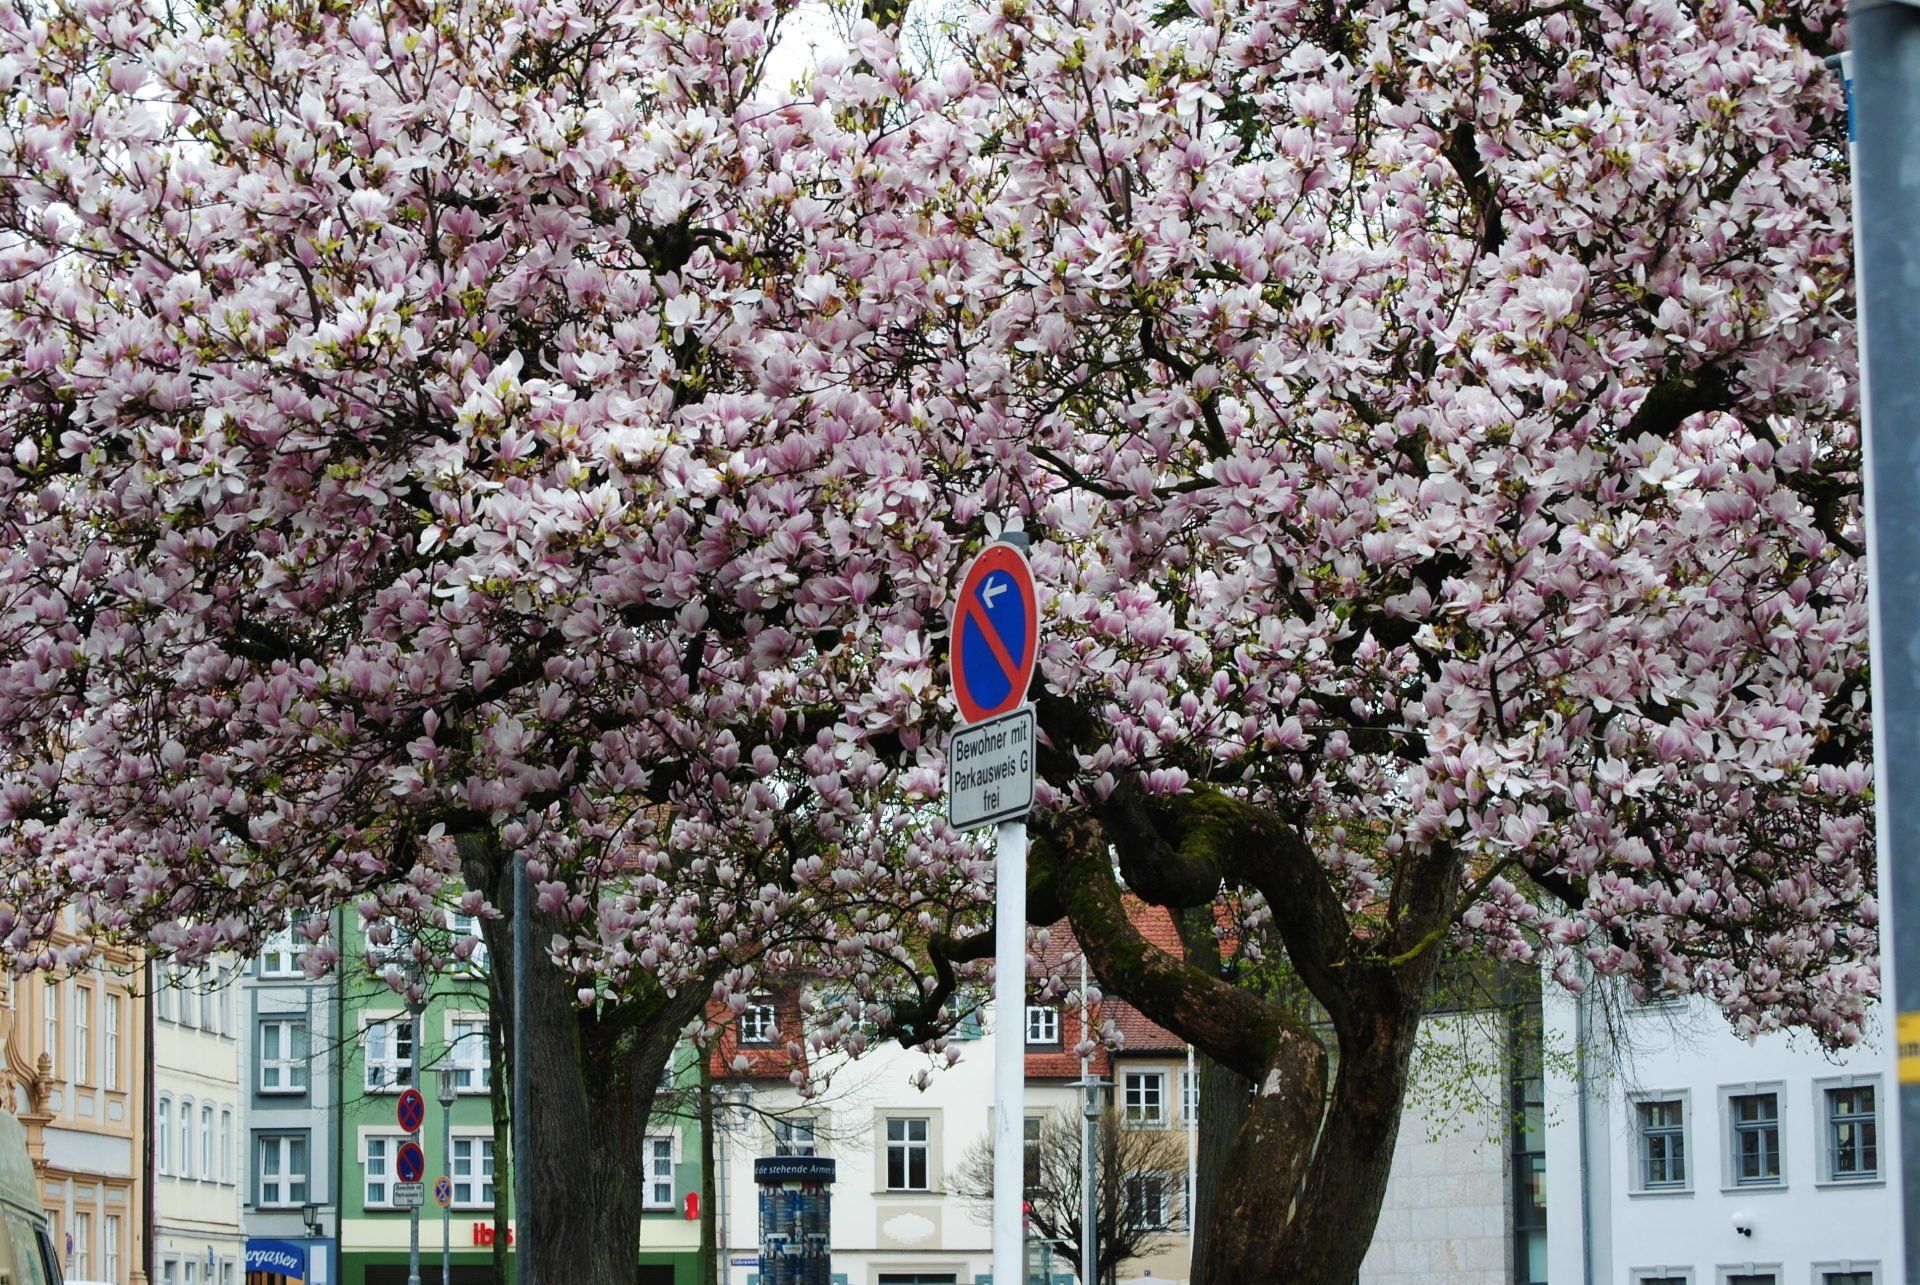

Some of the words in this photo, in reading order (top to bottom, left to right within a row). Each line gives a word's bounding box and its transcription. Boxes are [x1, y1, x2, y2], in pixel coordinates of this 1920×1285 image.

[956, 731, 1007, 762] Bewohner
[1011, 720, 1027, 745] mit
[955, 755, 1016, 792] Parkausweis
[1020, 750, 1028, 773] G
[983, 786, 1000, 811] frei
[768, 1164, 808, 1174] stehende
